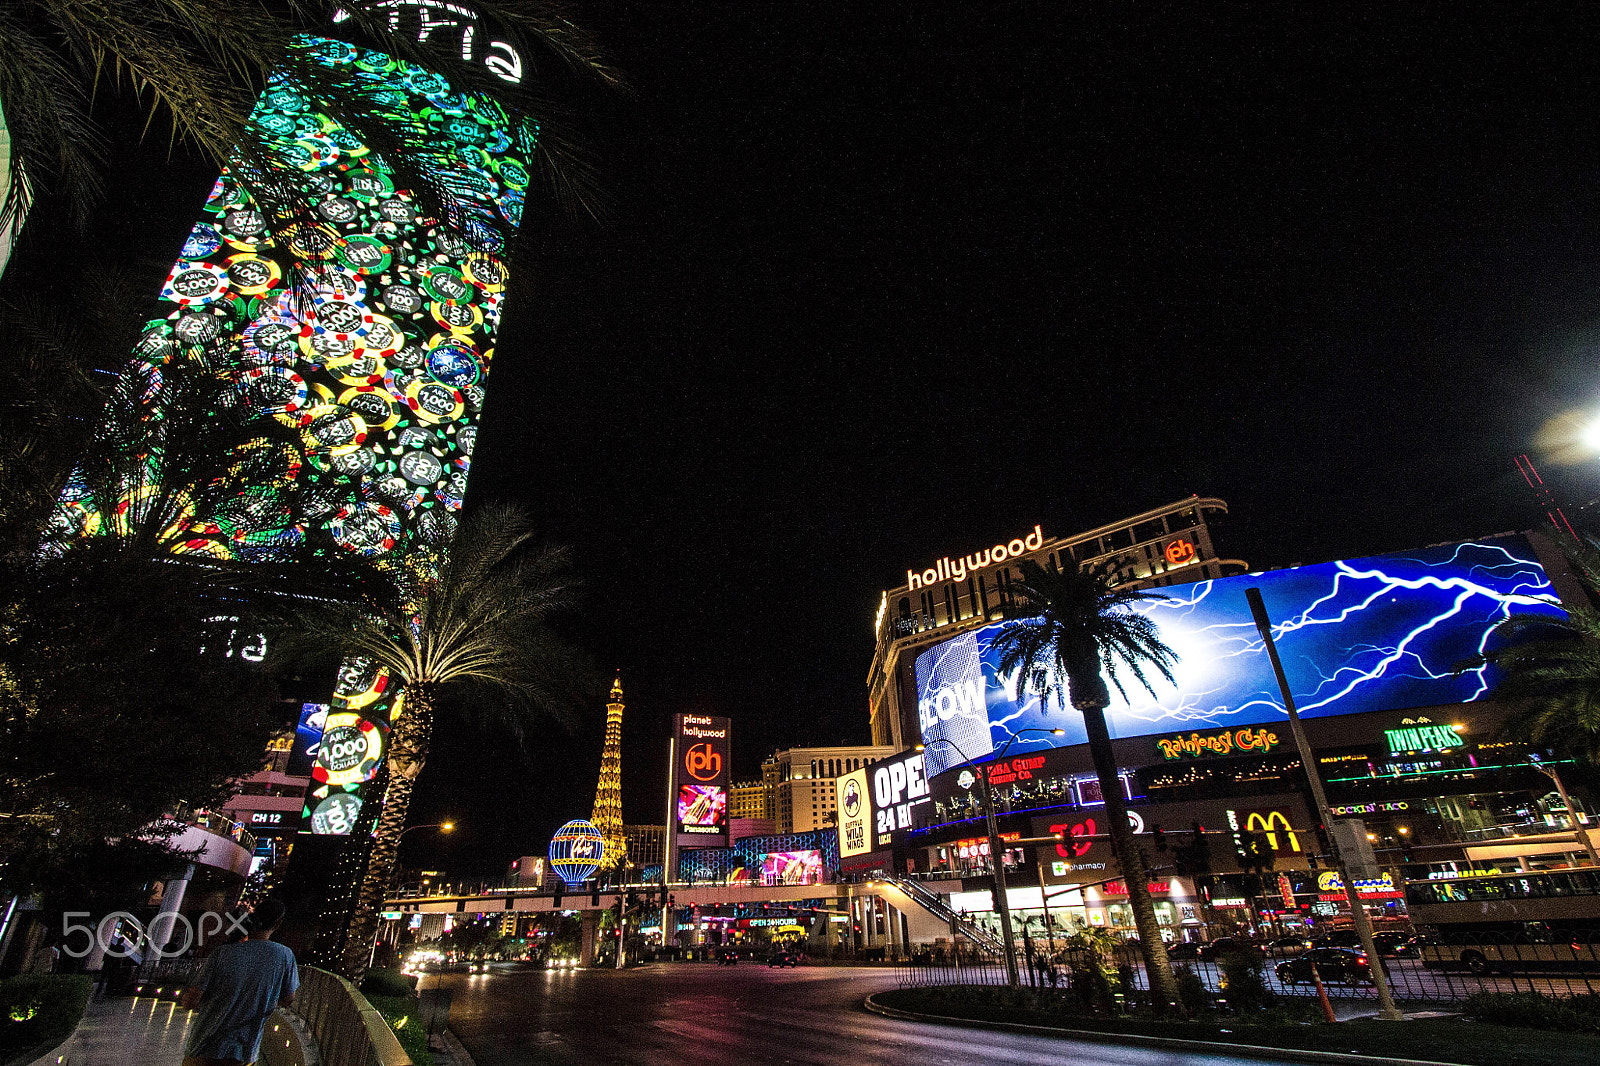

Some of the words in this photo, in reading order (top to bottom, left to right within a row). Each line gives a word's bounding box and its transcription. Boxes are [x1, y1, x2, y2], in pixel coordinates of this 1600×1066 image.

[184, 272, 204, 281] ARIA
[432, 388, 448, 400] ARIA
[1169, 539, 1194, 563] ph
[907, 525, 1044, 591] hollywood
[918, 674, 987, 735] BLOW
[683, 713, 712, 725] planet
[683, 726, 726, 739] hollywood
[1384, 727, 1422, 752] TWIN
[1418, 724, 1463, 750] PEAKS
[1157, 731, 1235, 760] Rainforest
[688, 743, 721, 778] ph
[1012, 756, 1046, 772] GUMP
[1379, 801, 1409, 812] TACO
[252, 813, 268, 823] CH
[269, 813, 282, 823] 12
[876, 807, 896, 834] 24
[684, 824, 720, 835] Panasonic
[845, 827, 864, 841] WILD
[846, 838, 864, 851] WINGS
[1069, 862, 1106, 871] pharmacy
[1183, 910, 1195, 919] 24
[750, 918, 766, 926] OPEN
[775, 918, 798, 926] HOURS
